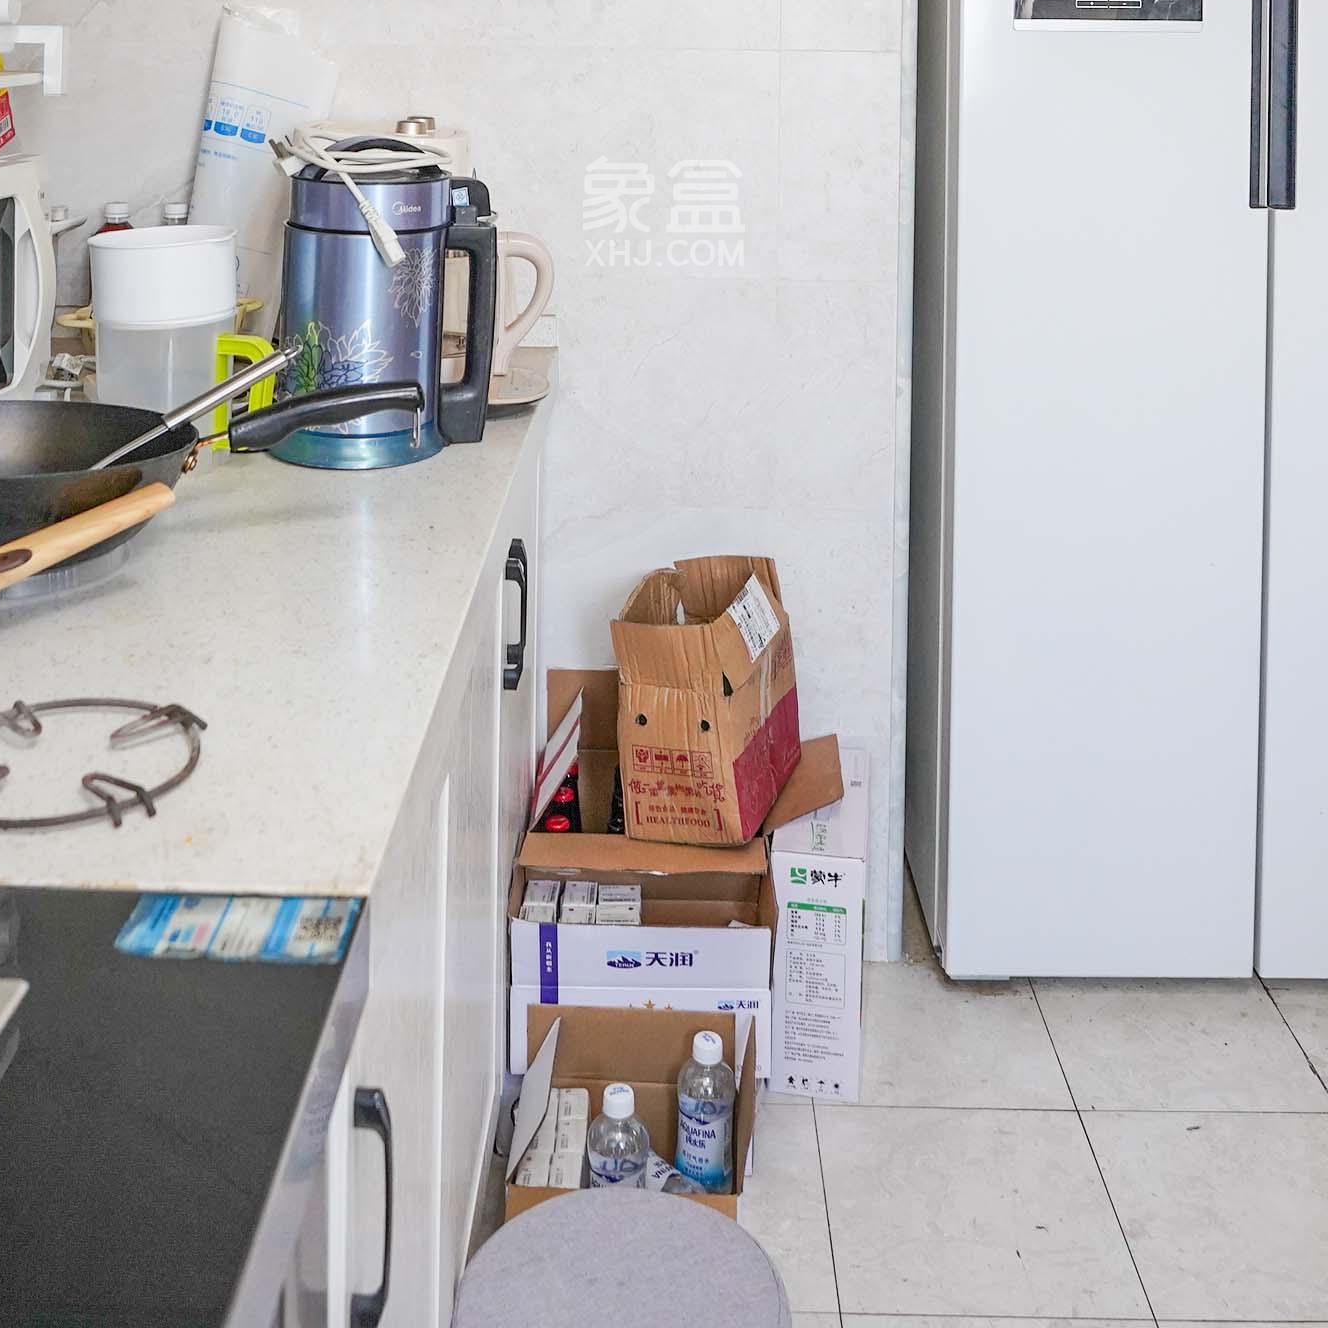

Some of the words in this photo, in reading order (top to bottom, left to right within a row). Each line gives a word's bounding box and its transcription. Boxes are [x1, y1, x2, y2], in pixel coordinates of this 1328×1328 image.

[810, 869, 843, 888] 蒙牛
[645, 951, 694, 967] 天润
[736, 1000, 759, 1009] 天润
[680, 1119, 717, 1140] AQUAFINA
